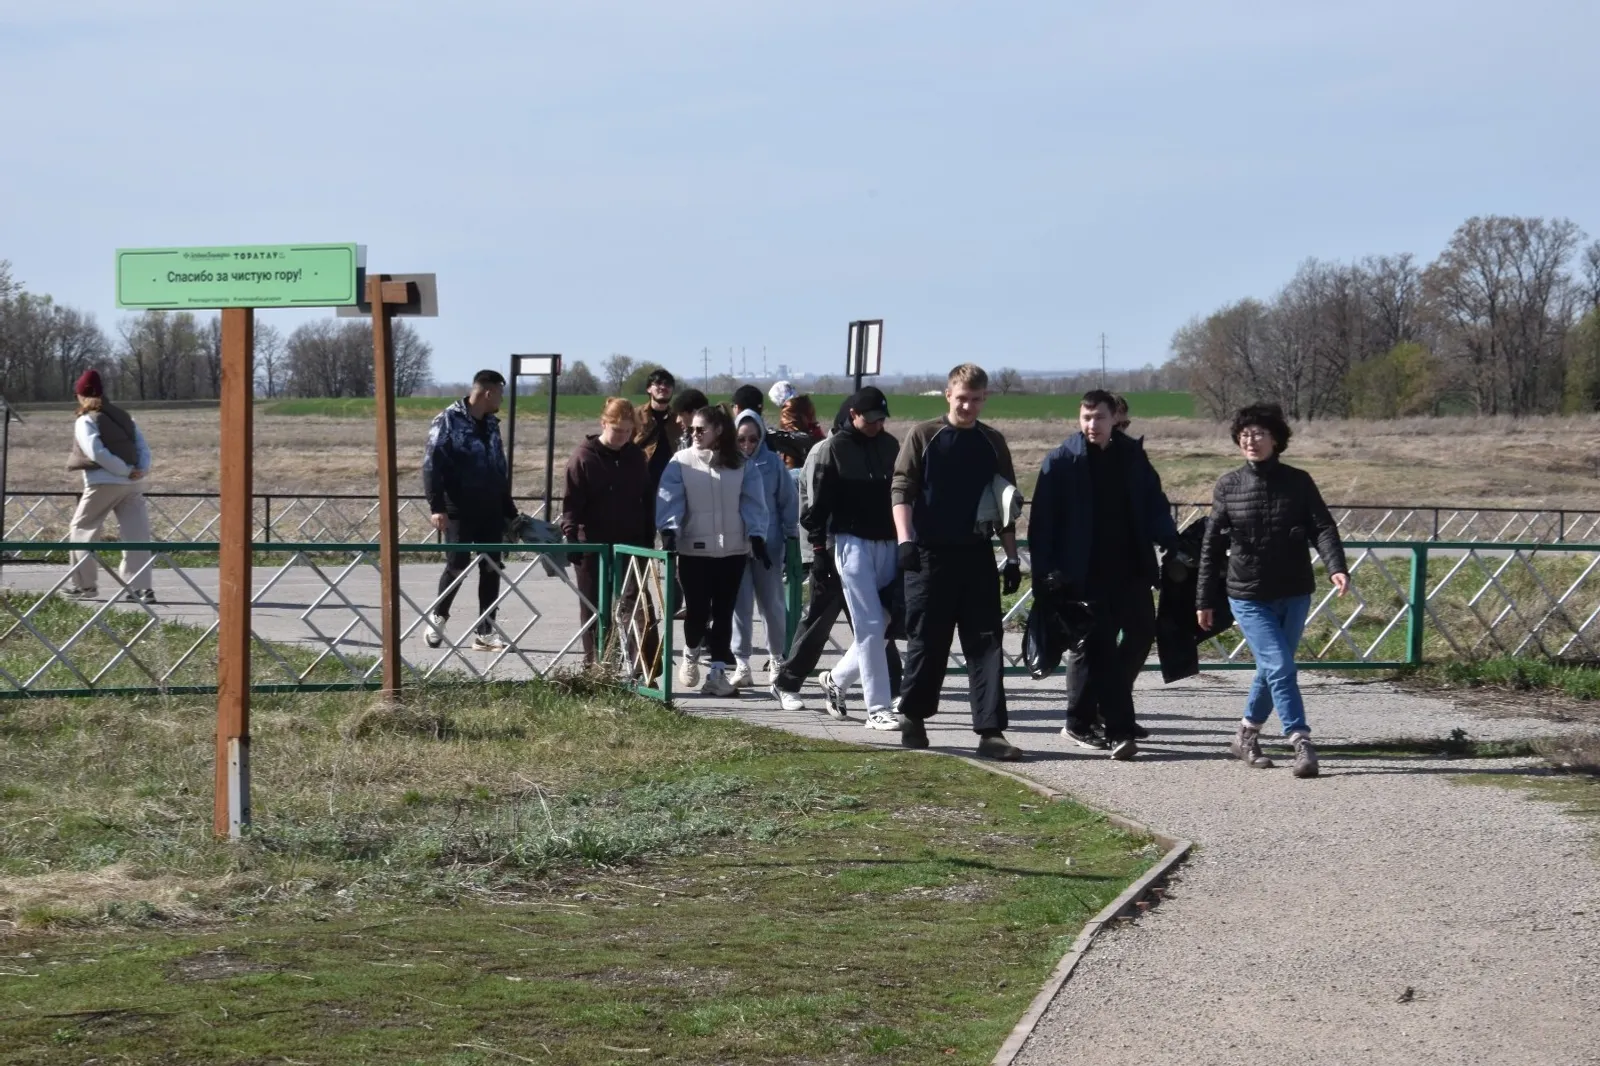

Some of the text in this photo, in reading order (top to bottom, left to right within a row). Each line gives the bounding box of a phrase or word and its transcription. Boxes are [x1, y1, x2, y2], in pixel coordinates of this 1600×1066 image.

[167, 268, 302, 284] Спасибо за чистую гору!
